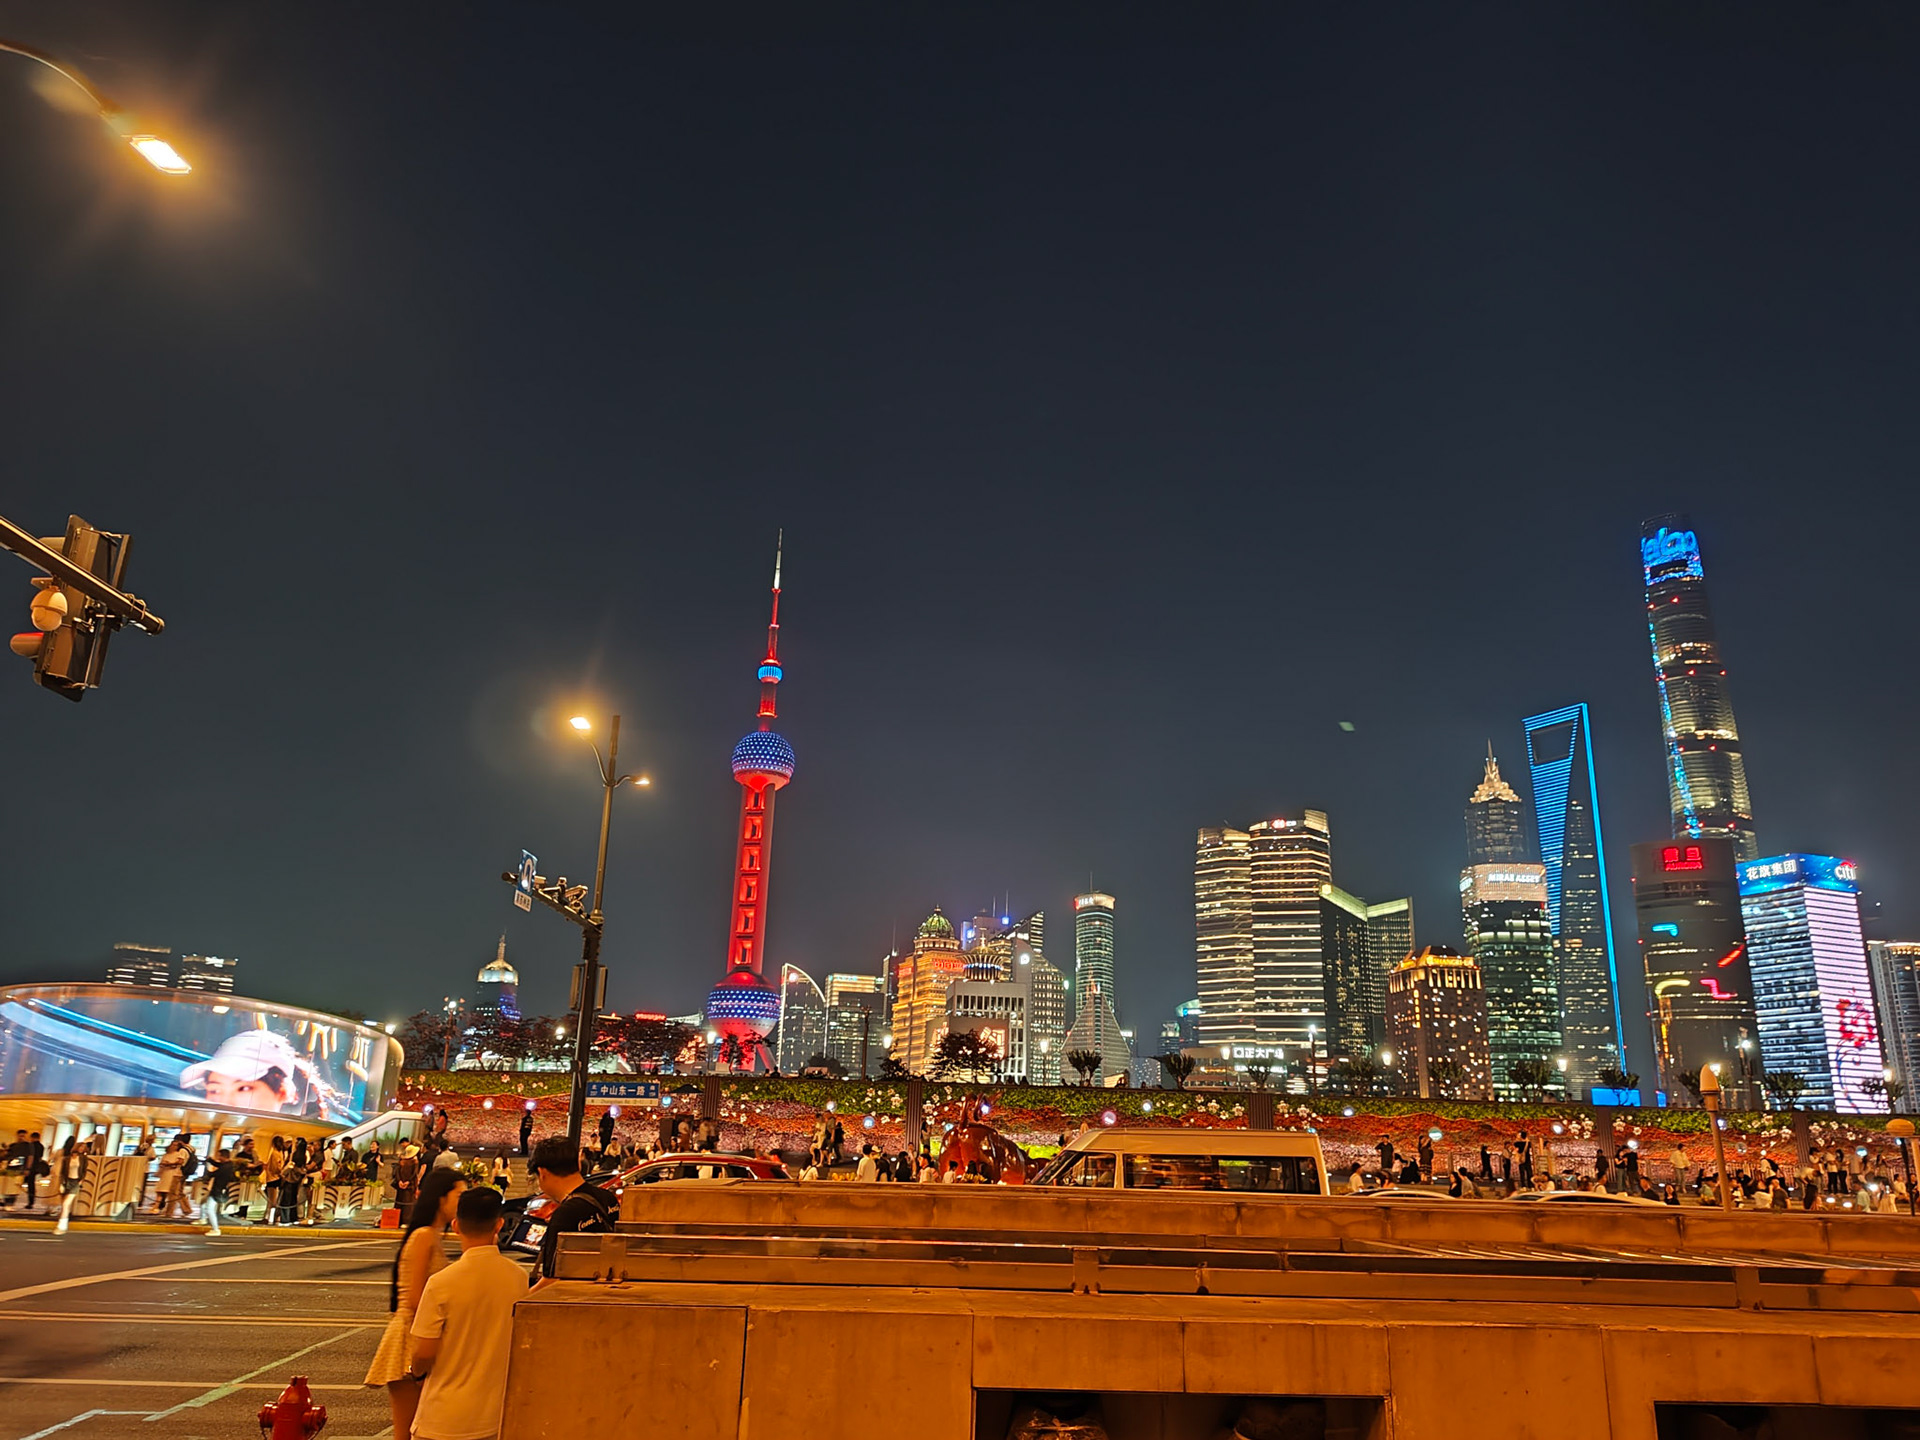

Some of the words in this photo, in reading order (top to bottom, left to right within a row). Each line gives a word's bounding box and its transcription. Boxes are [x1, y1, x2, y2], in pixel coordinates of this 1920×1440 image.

[1746, 859, 1797, 881] 花旗集团
[1244, 1047, 1284, 1059] 正大广场
[600, 1085, 646, 1096] 中山东一路
